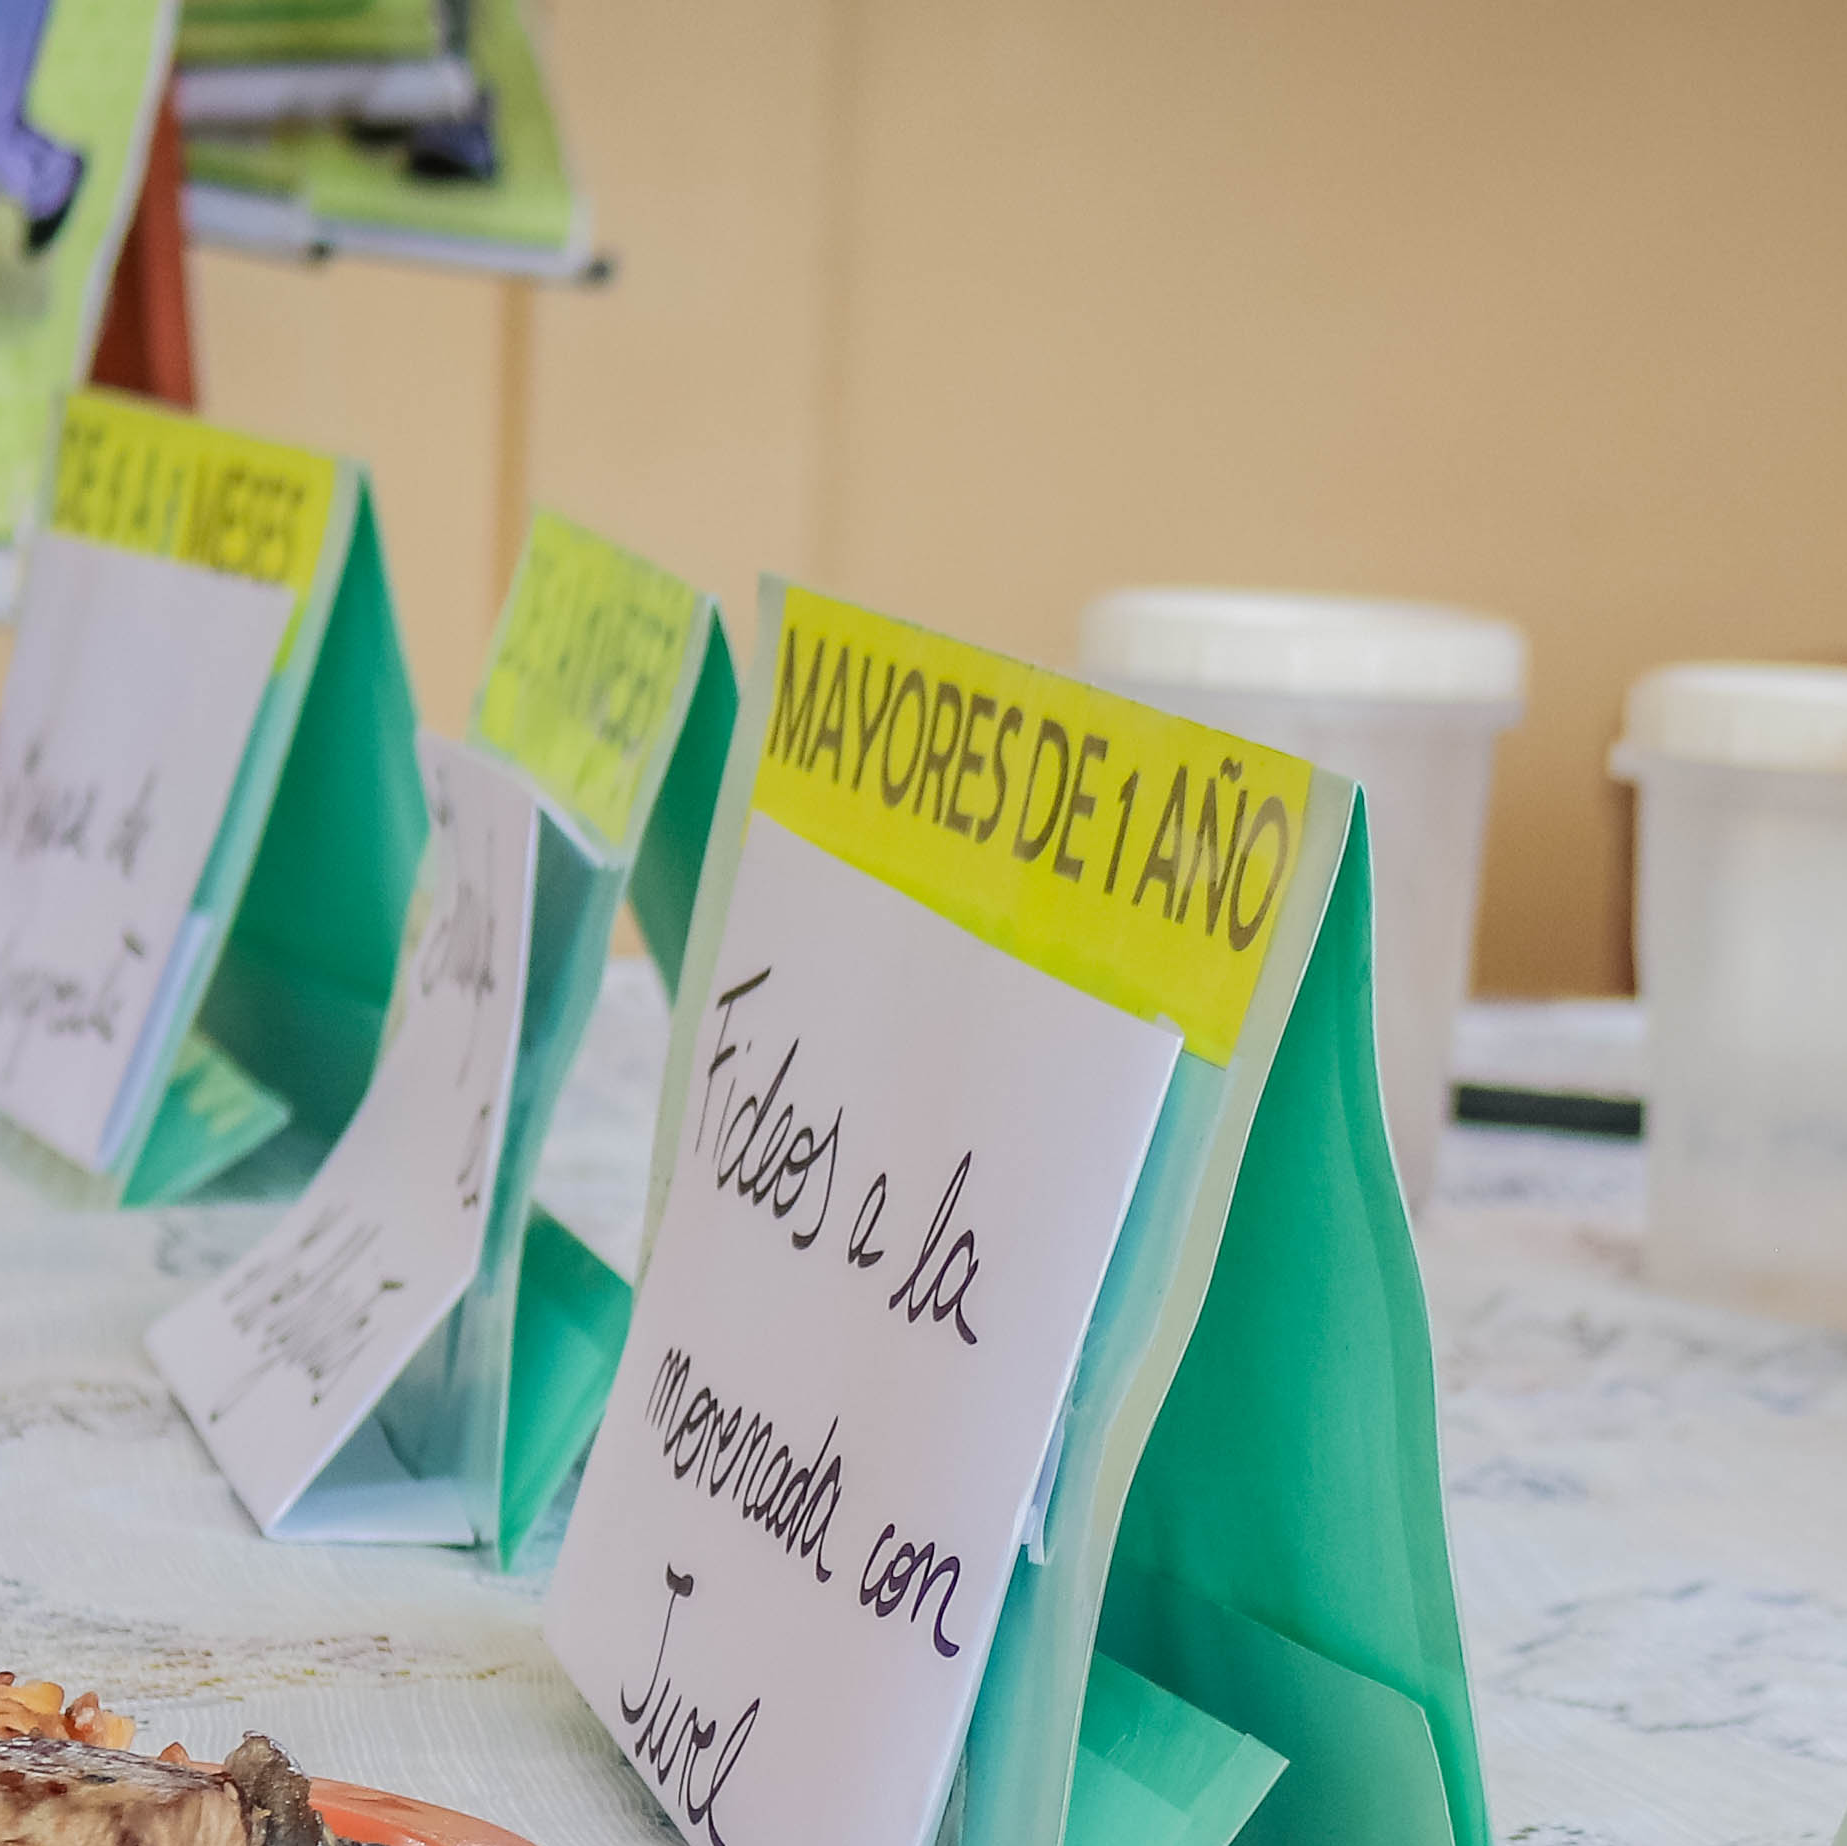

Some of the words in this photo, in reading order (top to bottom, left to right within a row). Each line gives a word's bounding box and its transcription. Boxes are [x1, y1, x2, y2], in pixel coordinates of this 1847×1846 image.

[767, 625, 1024, 845] MAYORES
[1011, 717, 1110, 883] DE
[1103, 769, 1140, 897] 1
[1131, 756, 1290, 953] AÑO
[694, 965, 844, 1250] Fideos
[847, 1172, 886, 1269] a
[888, 1149, 979, 1346] la
[645, 1343, 843, 1584] morenada
[858, 1519, 960, 1659] con
